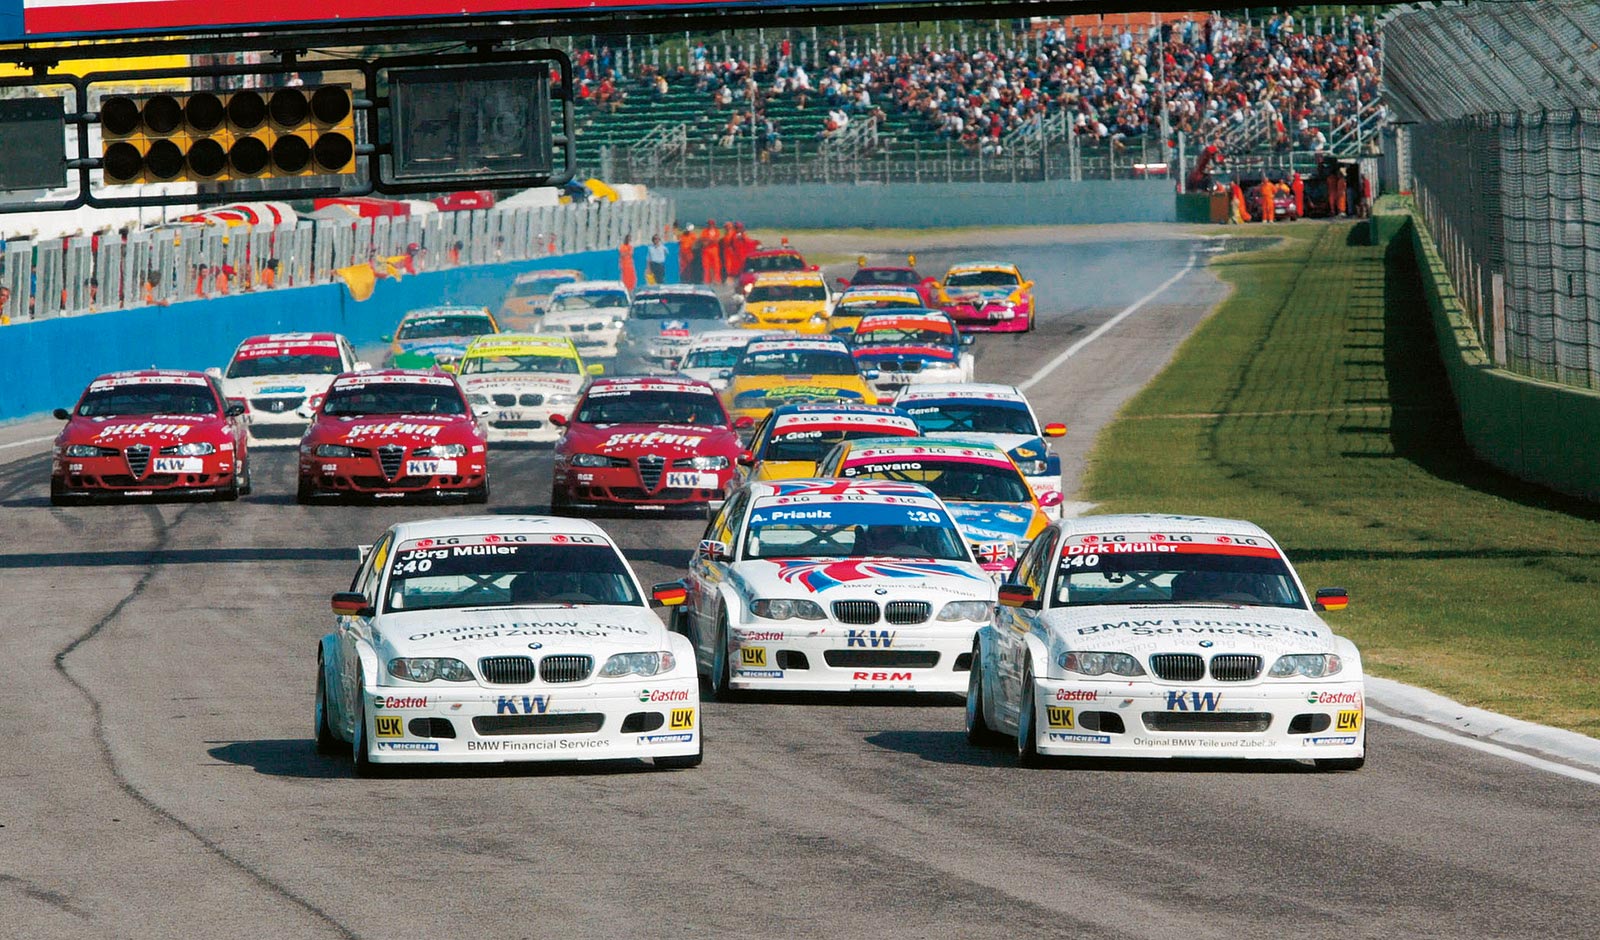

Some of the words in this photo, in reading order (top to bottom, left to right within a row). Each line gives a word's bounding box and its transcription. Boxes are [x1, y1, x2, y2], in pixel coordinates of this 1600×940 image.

[498, 411, 523, 419] KW
[155, 459, 185, 471] KW
[409, 461, 439, 473] KW
[845, 467, 861, 477] S.
[864, 462, 922, 473] Tavano
[669, 473, 700, 486] KW
[750, 514, 768, 524] A.
[771, 510, 832, 520] Priaulx
[436, 537, 460, 545] LG
[503, 535, 528, 543] LG
[570, 536, 594, 544] LG
[1102, 535, 1126, 543] LG
[1169, 535, 1193, 543] LG
[1234, 537, 1258, 546] LG
[402, 549, 449, 560] Jörg
[453, 545, 519, 556] Müller
[1068, 543, 1110, 555] Dirk
[1113, 543, 1178, 553] Müller
[408, 624, 505, 641] Original
[590, 621, 649, 635] Teile
[1076, 619, 1163, 636] BMW
[1172, 619, 1319, 638] Financial
[1131, 626, 1273, 638] Services
[453, 631, 499, 641] und
[747, 631, 785, 641] Castrol
[847, 629, 896, 648] KW
[742, 670, 783, 678] MICHELIN
[853, 671, 913, 681] RBM
[650, 689, 689, 702] Castrol
[1056, 688, 1098, 701] Castrol
[1319, 691, 1357, 704] Castrol
[385, 696, 428, 709] Castrol
[497, 695, 551, 714] KW
[1166, 691, 1222, 711] KW
[650, 734, 691, 743] MICHELIN
[1063, 733, 1109, 743] MICHELIN
[1133, 737, 1170, 748] Original
[1171, 738, 1197, 747] BMW
[1198, 738, 1219, 747] Teile
[1220, 739, 1239, 748] und
[393, 742, 438, 751] MICHELIN
[467, 741, 500, 751] BMW
[502, 740, 557, 751] Financial
[559, 739, 610, 749] Services
